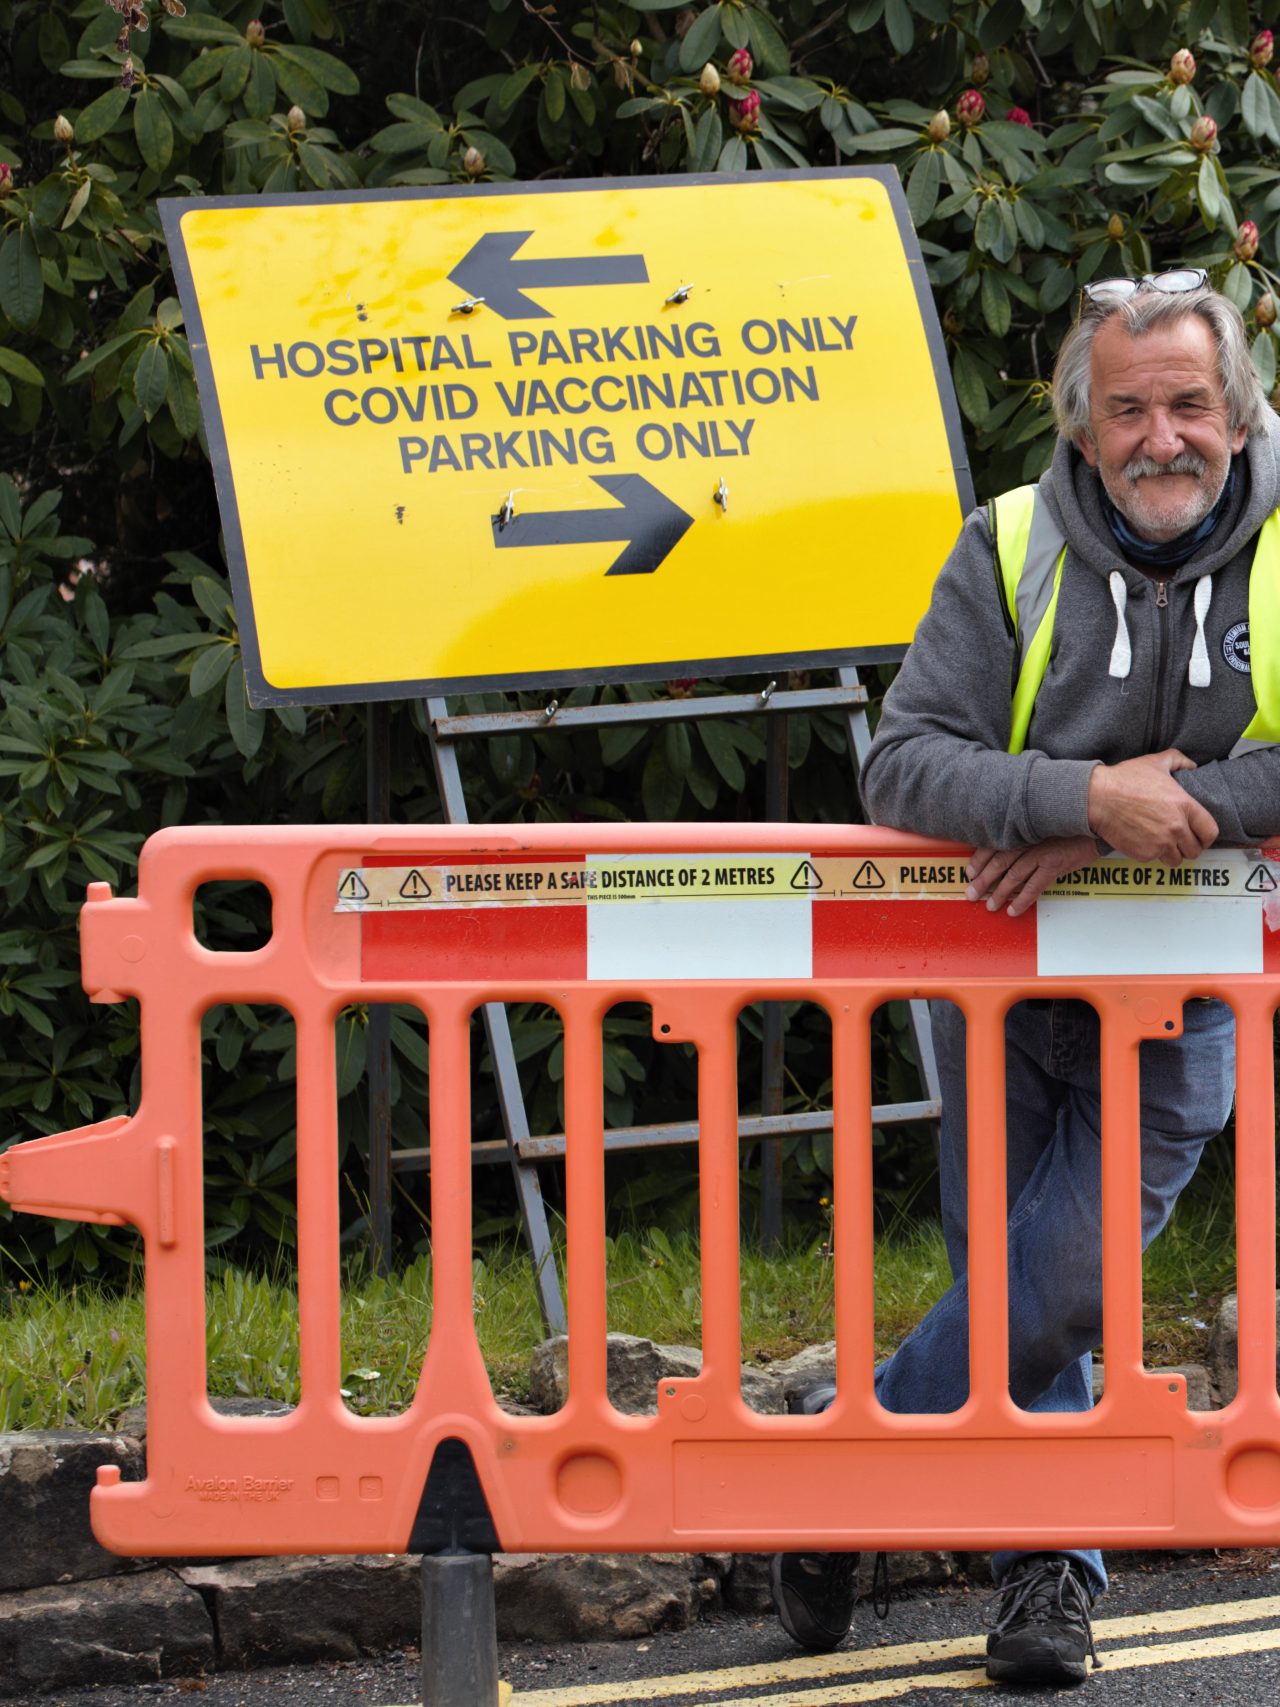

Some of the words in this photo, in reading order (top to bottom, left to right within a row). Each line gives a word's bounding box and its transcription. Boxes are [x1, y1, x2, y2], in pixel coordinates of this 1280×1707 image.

[250, 333, 492, 380] HOSPITAL
[508, 321, 720, 367] PARKING
[741, 314, 858, 356] ONLY
[323, 383, 479, 427] COVID
[496, 366, 820, 417] VACCINATION
[398, 426, 616, 474] PARKING
[636, 418, 756, 461] ONLY
[446, 873, 501, 892] PLEASE
[505, 872, 544, 891] KEEP
[547, 872, 558, 890] A
[601, 869, 675, 889] DISTANCE
[678, 868, 697, 887] OF
[701, 868, 711, 886] 2
[714, 867, 775, 886] METRES
[900, 866, 956, 884] PLEASE
[1132, 867, 1152, 886] OF
[1156, 868, 1165, 886] 2
[1169, 868, 1230, 887] METRES
[184, 1475, 238, 1492] Avalon
[243, 1475, 295, 1492] Barrier
